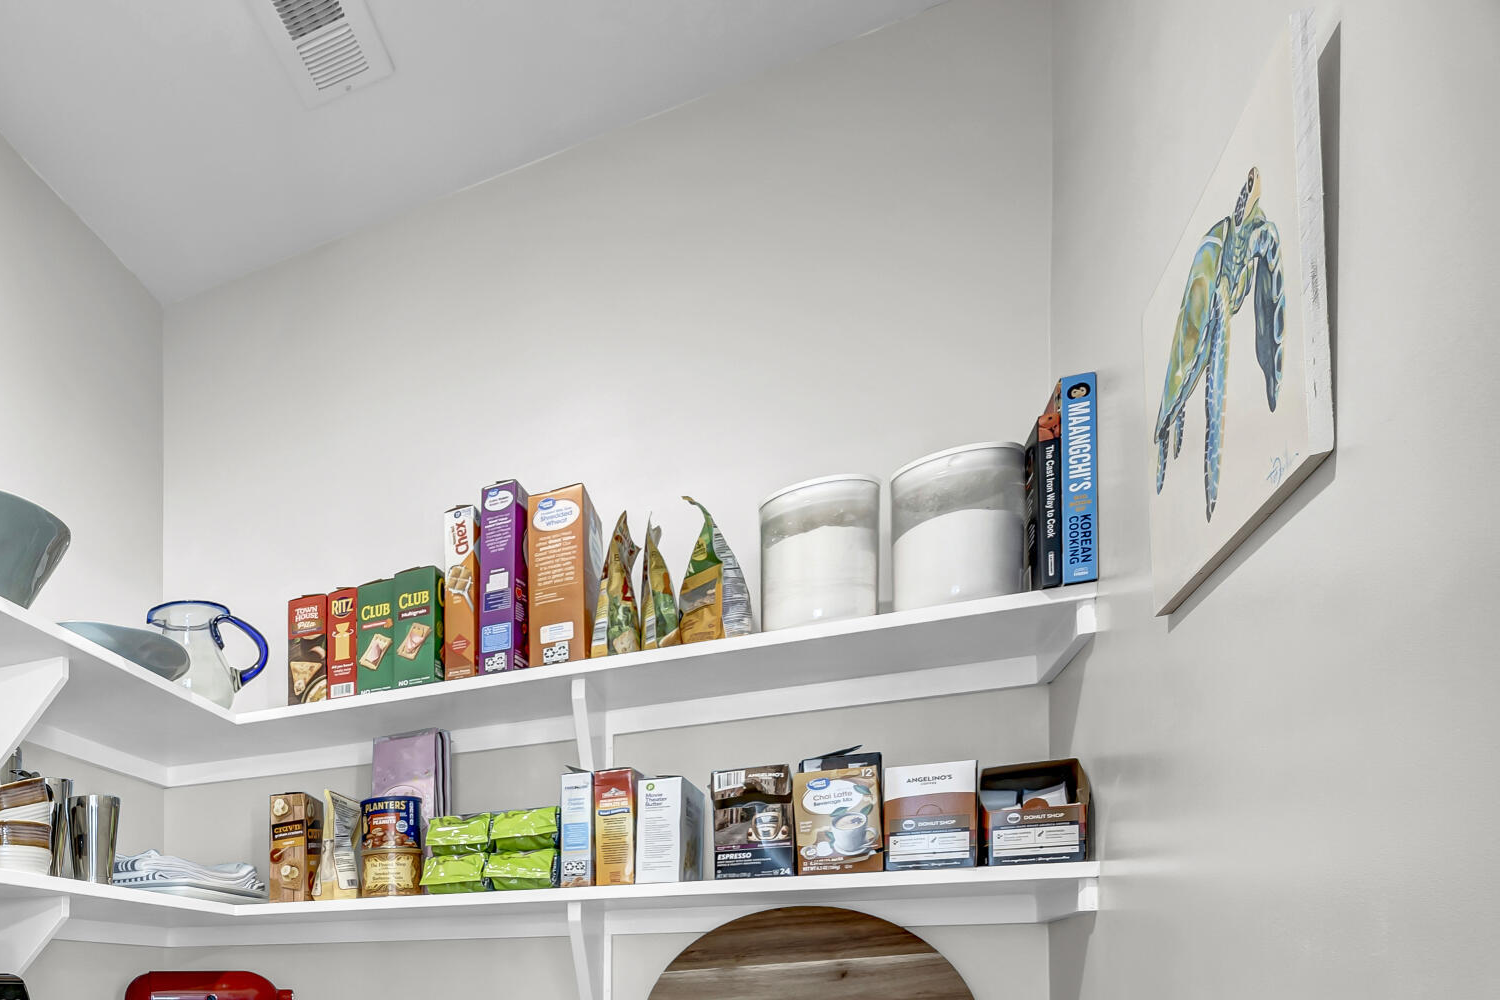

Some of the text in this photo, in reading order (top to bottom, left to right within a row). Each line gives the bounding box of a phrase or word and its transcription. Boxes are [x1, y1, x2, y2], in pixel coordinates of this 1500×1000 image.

[1068, 400, 1092, 493] MAANGCHI'S
[1045, 444, 1056, 539] The Cast Iron Way to Cook
[455, 520, 469, 555] Chex
[1068, 515, 1080, 565] COOKING
[1080, 513, 1092, 563] KOREAN
[398, 590, 430, 609] CLUB
[295, 605, 319, 615] TOWN
[331, 598, 354, 616] RITZ
[361, 603, 391, 621] CLUB
[401, 608, 427, 618] Multigrain
[295, 612, 319, 623] HOUSE
[861, 768, 873, 777] 12
[906, 774, 953, 784] ANGELINO'S
[813, 793, 832, 801] Chai
[365, 800, 407, 813] PLANTERS
[717, 852, 752, 860] ESPRESSO
[780, 867, 791, 875] 24
